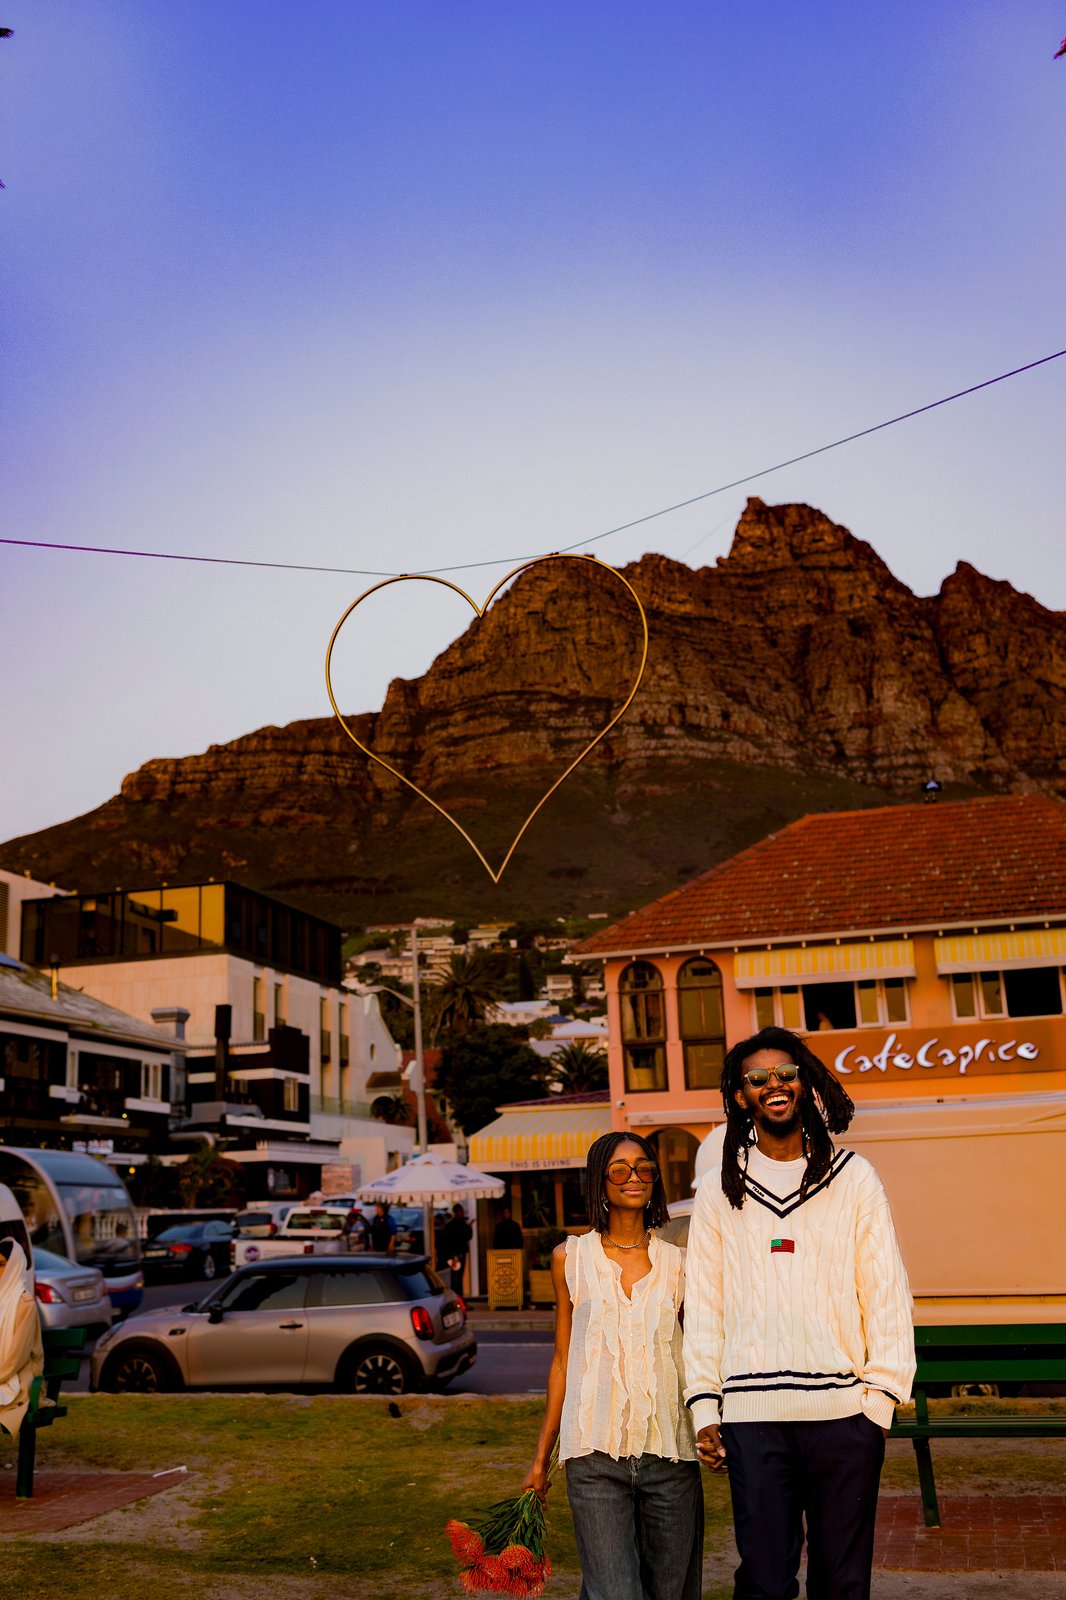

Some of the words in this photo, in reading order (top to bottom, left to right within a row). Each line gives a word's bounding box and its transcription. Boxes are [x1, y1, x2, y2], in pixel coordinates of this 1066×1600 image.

[834, 1033, 914, 1074] Café
[916, 1038, 1040, 1074] Caprice
[510, 1161, 528, 1169] THIS
[532, 1160, 540, 1168] IS
[543, 1158, 571, 1168] LIVING
